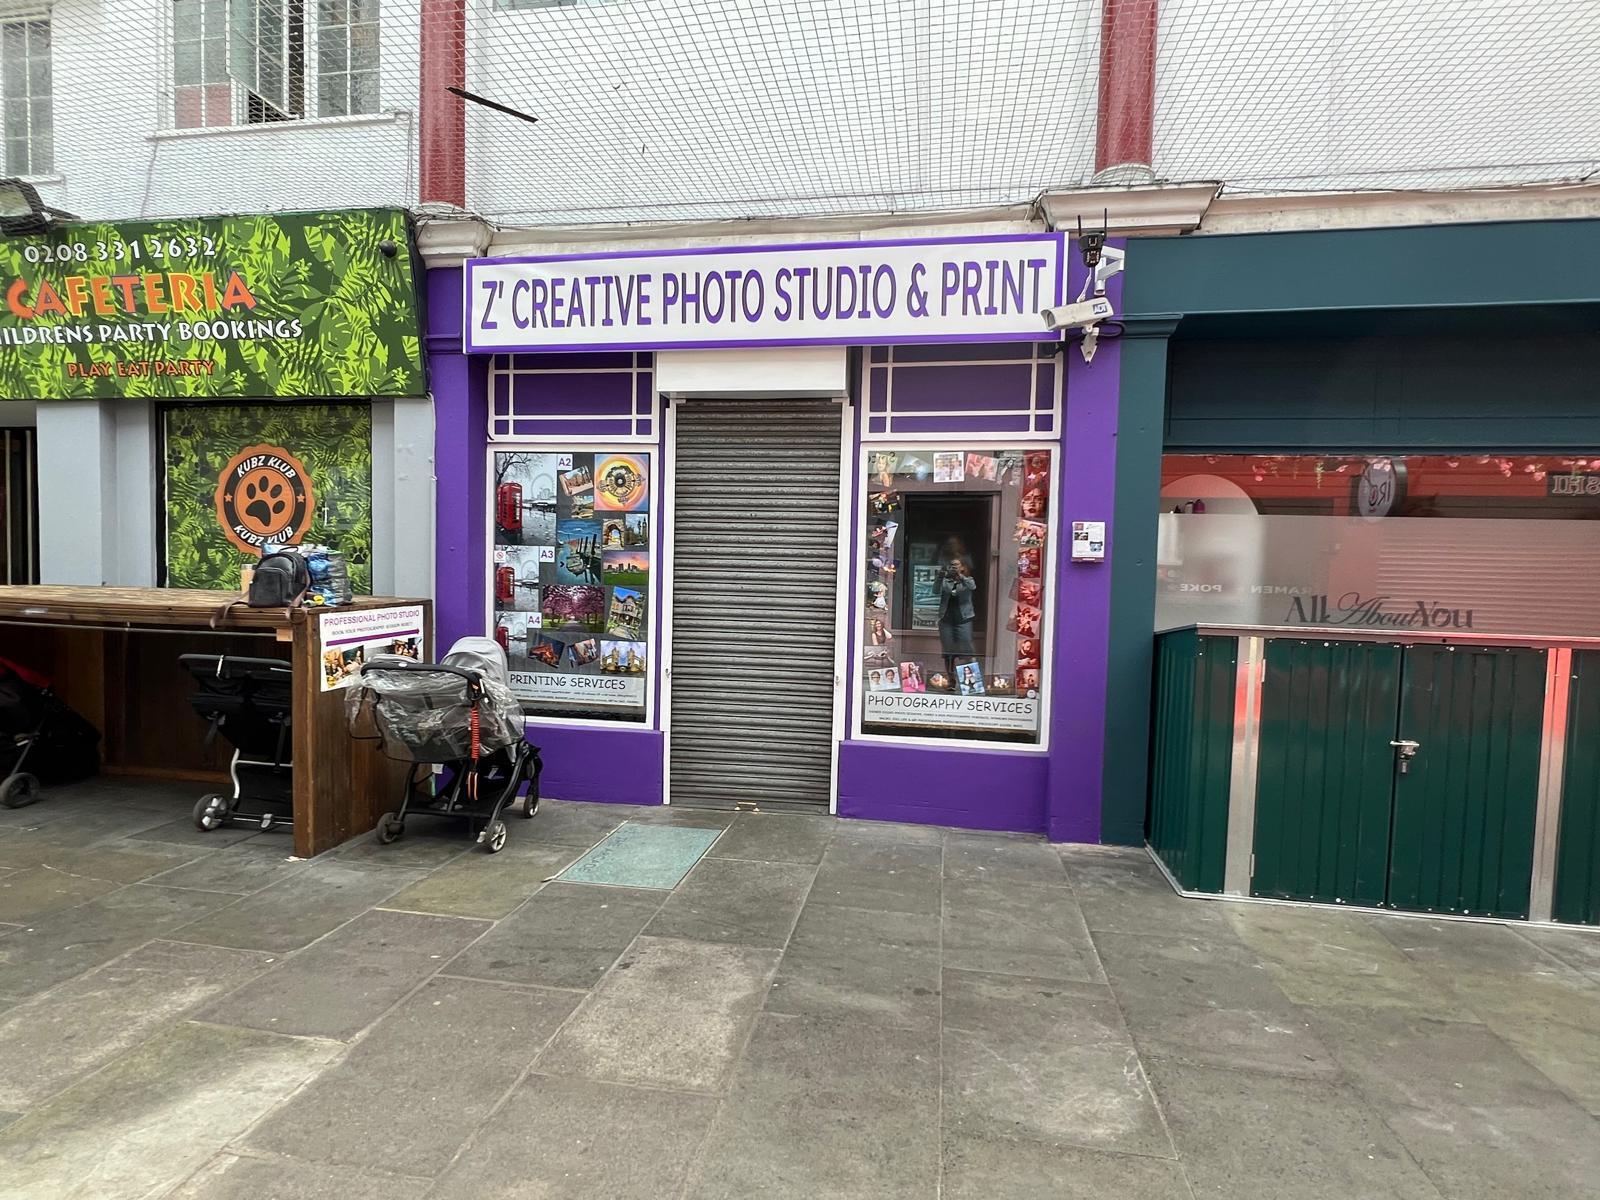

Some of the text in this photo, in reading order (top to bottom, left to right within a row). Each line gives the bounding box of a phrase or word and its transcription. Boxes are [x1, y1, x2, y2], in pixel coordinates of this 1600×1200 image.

[24, 236, 216, 263] 0208 331 2632
[7, 271, 257, 319] CAFETERIA
[512, 273, 652, 329] CREATIVE
[662, 270, 765, 325] PHOTO
[774, 264, 897, 322] STUDIO
[906, 262, 929, 318] &
[941, 258, 1047, 316] PRINT
[1093, 303, 1108, 314] ADT
[0, 318, 303, 345] ILDRENS PARTY BOOKINGS
[67, 360, 214, 377] PLAY EAT PARTY
[237, 455, 296, 479] KUBZ KLUB
[558, 457, 572, 468] A2
[234, 524, 265, 546] KUBZ
[540, 549, 554, 559] A3
[324, 609, 420, 627] PROFESSIONAL PHOTO STUDIO
[527, 615, 541, 625] A4
[1284, 592, 1473, 628] All About You
[510, 673, 627, 690] PRINTING SERVICES
[868, 694, 1033, 714] PHOTOGRAPHY SERVICES
